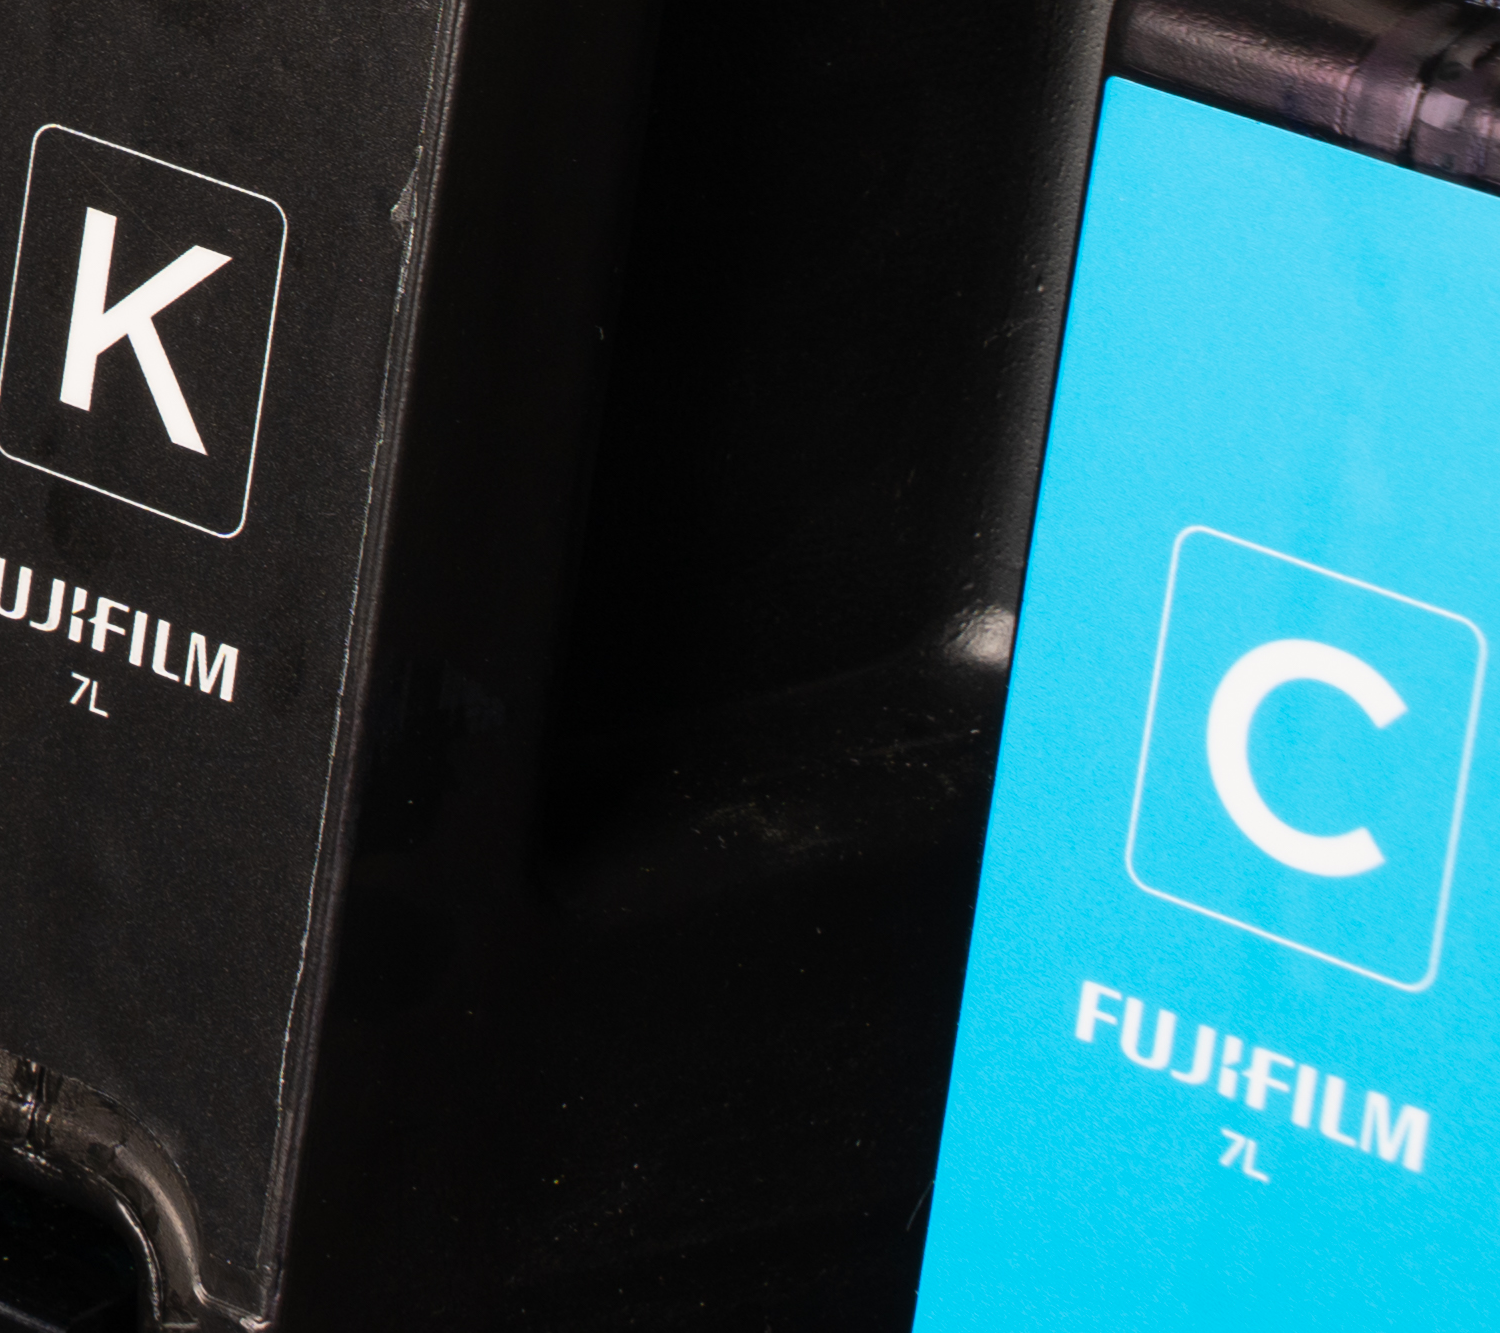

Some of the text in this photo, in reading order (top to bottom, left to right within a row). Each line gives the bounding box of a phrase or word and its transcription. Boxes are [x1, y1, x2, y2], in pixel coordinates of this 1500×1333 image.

[60, 206, 232, 456] K
[68, 671, 109, 719] 7L
[1205, 638, 1408, 878] C
[1074, 979, 1431, 1173] FUJIFILM
[1218, 1127, 1270, 1184] 7L
